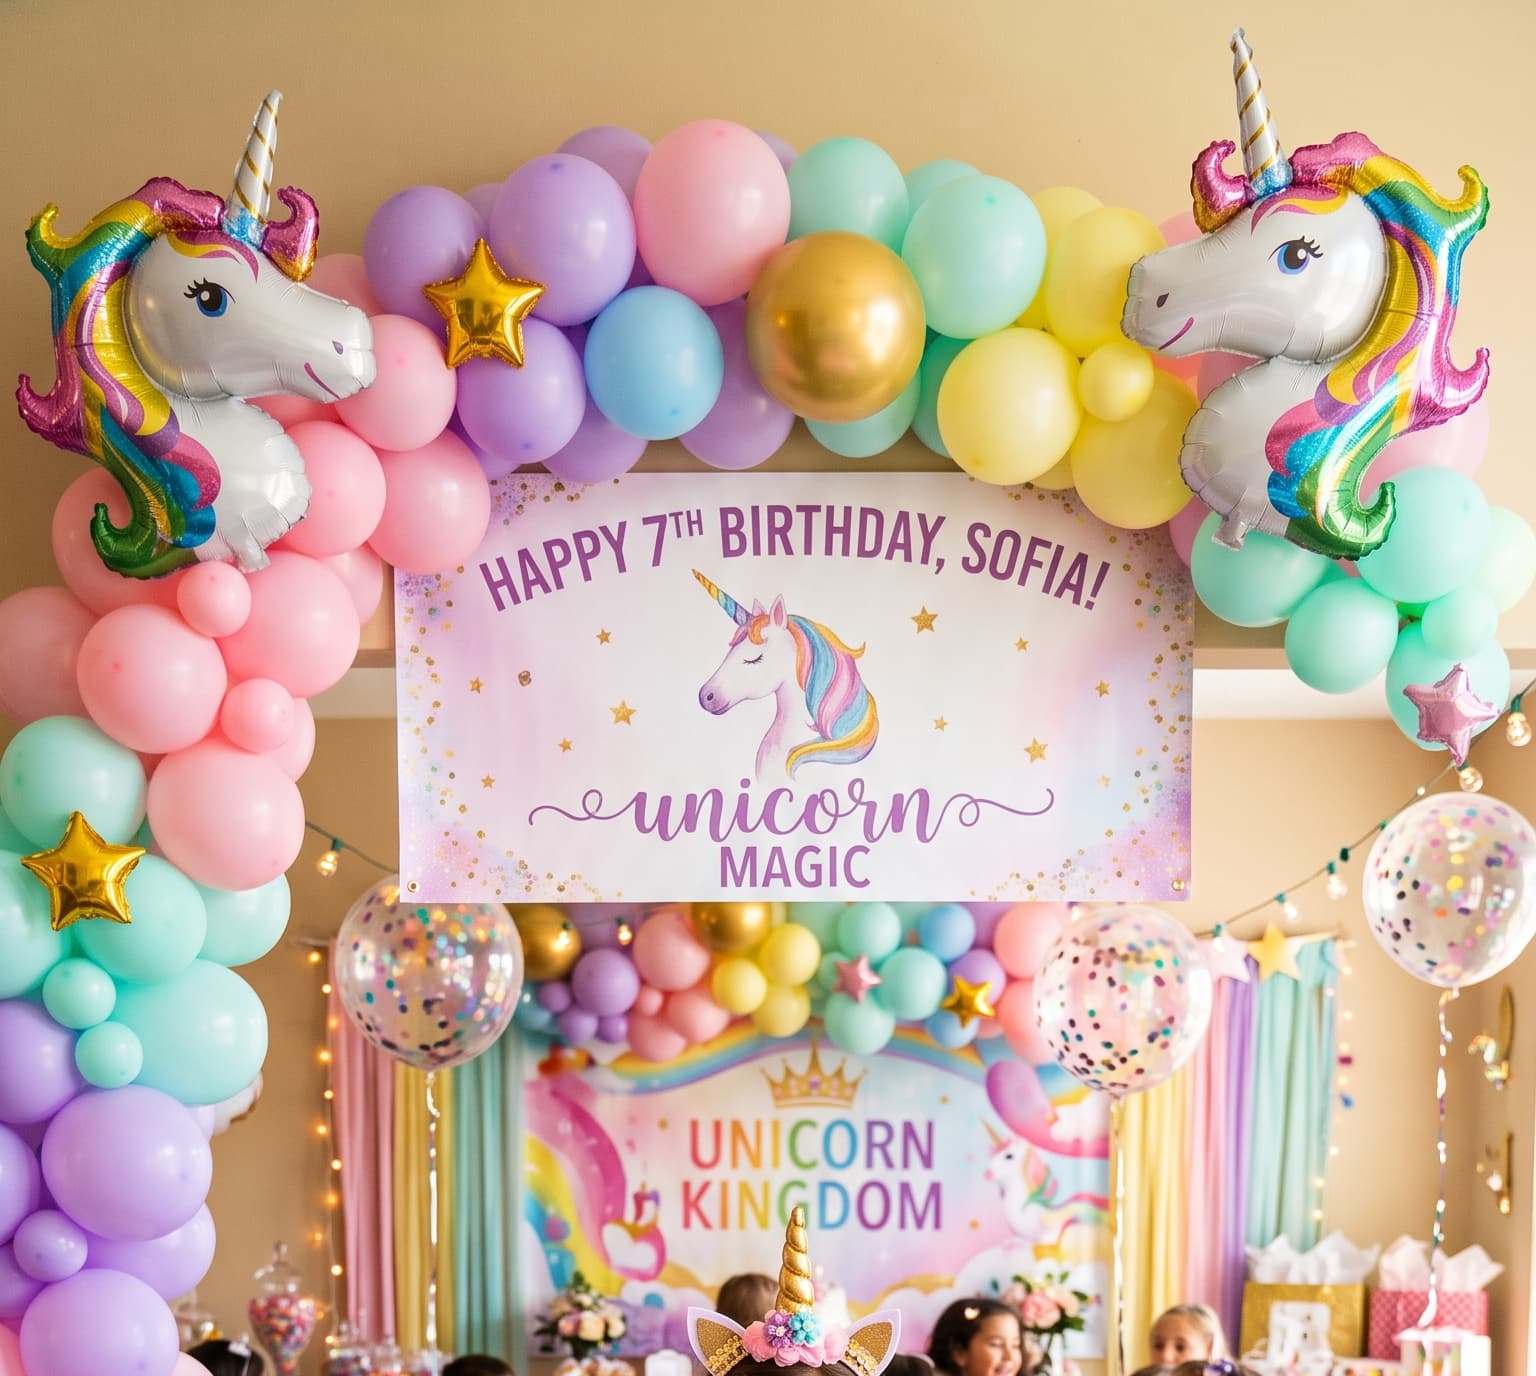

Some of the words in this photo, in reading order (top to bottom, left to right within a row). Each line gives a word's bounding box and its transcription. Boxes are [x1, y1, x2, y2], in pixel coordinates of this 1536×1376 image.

[478, 520, 628, 612] HAPPY
[642, 509, 705, 567] 7TH
[719, 503, 946, 575] BIRTHDAY,
[961, 522, 1112, 611] SOFIA!
[528, 776, 1056, 844] unicorn
[719, 844, 872, 888] MAGIC
[688, 1118, 934, 1170] UNICORN
[681, 1179, 942, 1231] KINGDOM
